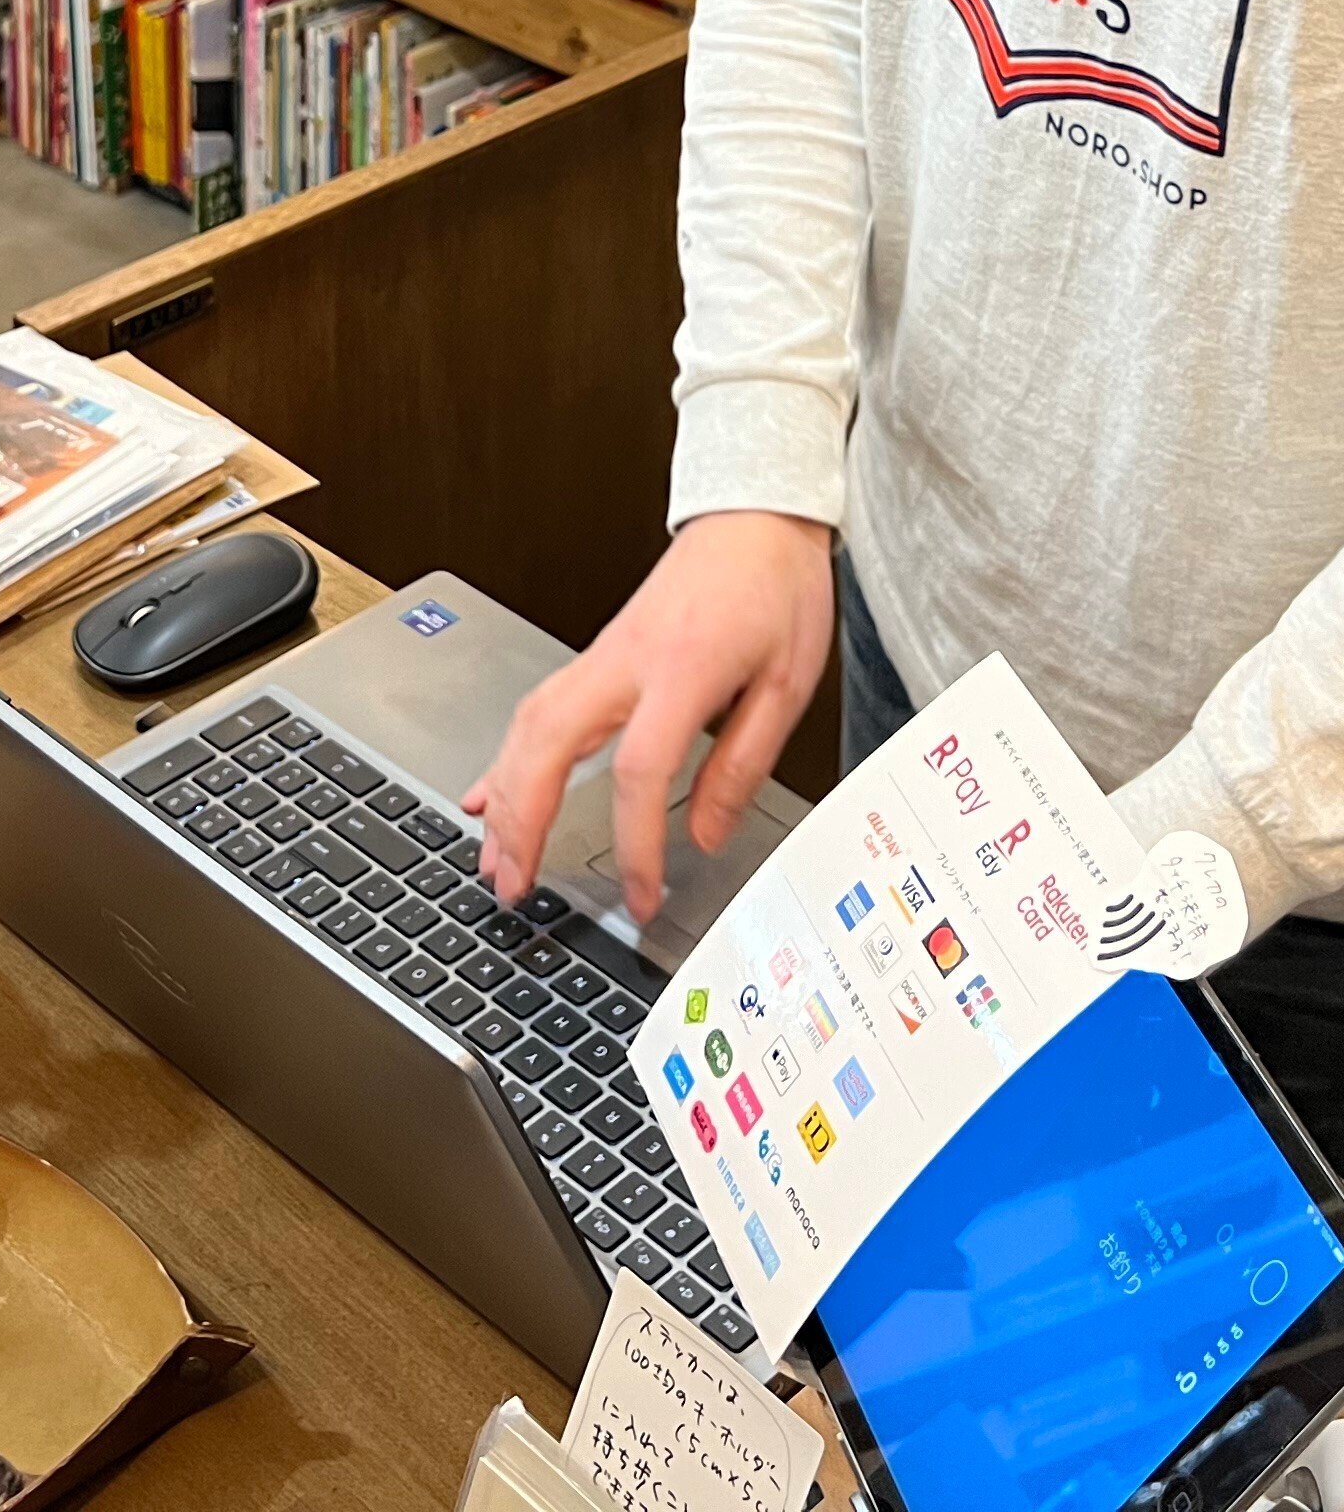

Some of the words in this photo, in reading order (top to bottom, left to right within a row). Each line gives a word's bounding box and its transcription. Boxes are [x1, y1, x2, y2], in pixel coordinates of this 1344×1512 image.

[1045, 112, 1208, 212] NORO.SHOP
[944, 757, 991, 816] Pay
[881, 833, 903, 858] PAY
[975, 841, 1002, 878] Edy
[899, 876, 926, 914] VISA
[1016, 895, 1054, 942] Card
[776, 1055, 792, 1083] Pay
[804, 1110, 831, 1153] iD
[716, 1156, 746, 1212] nimoca
[785, 1187, 821, 1250] manaca
[1098, 1232, 1143, 1296] お釣り
[639, 1307, 746, 1416] ステッカーは、
